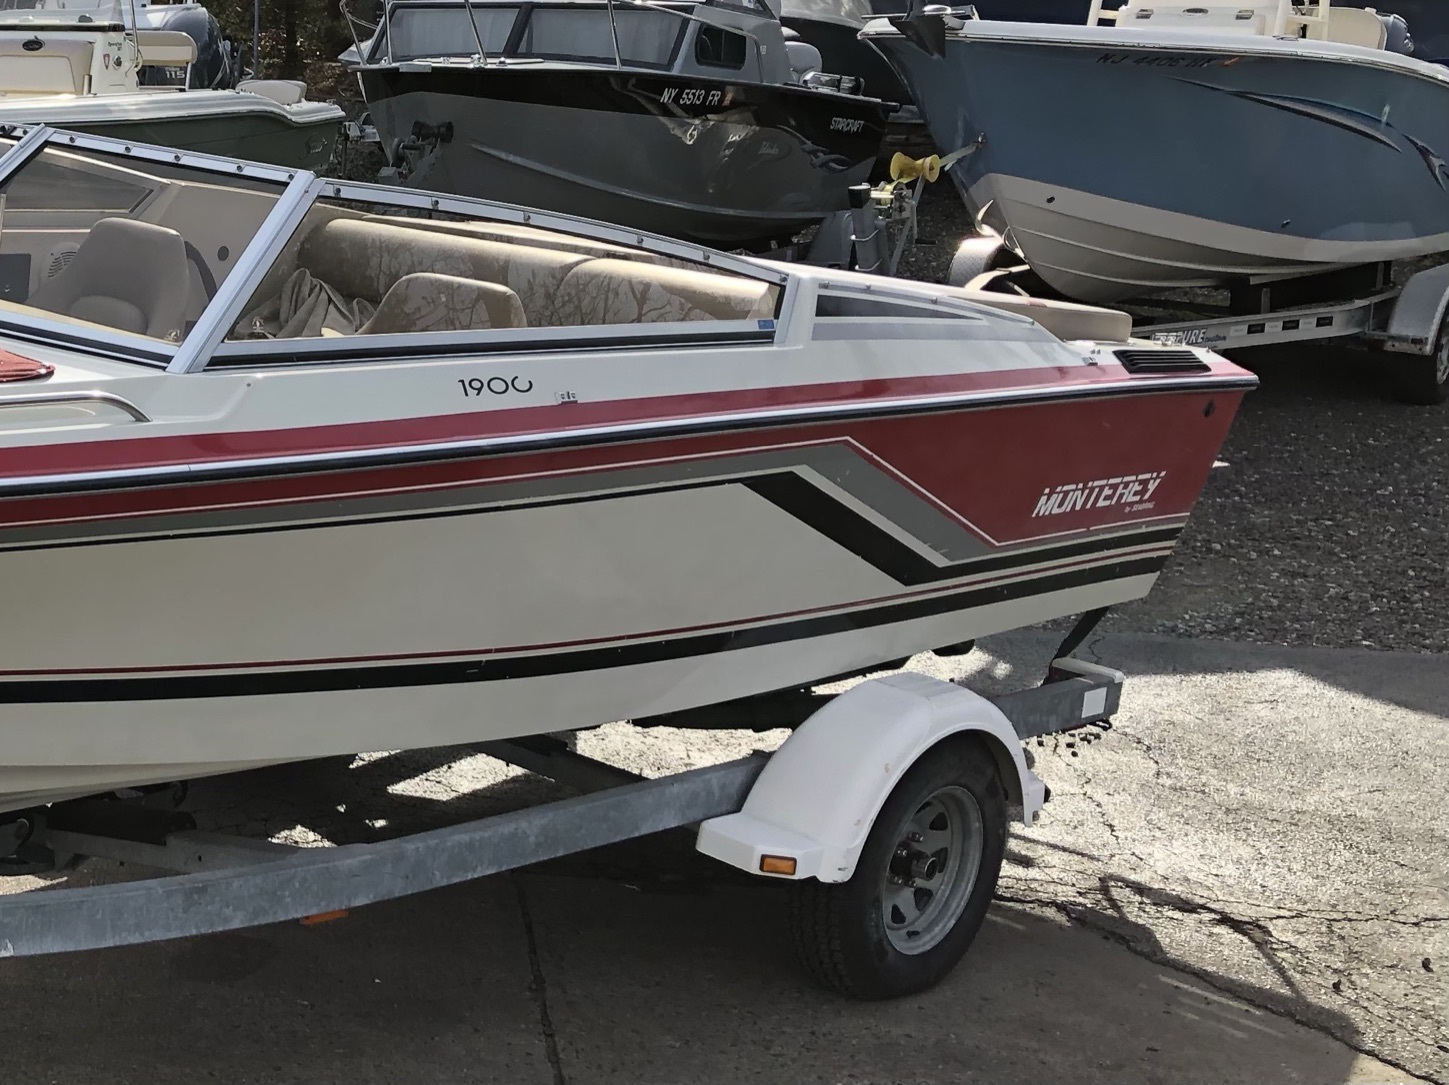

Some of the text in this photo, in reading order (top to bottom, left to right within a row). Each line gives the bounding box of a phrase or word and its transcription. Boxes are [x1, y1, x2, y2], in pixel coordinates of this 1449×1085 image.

[1096, 52, 1130, 65] NJ
[165, 71, 186, 80] 115
[659, 87, 722, 106] NY 5513 FR
[830, 117, 865, 133] STARCRAFT
[1032, 470, 1167, 518] MONTEREY
